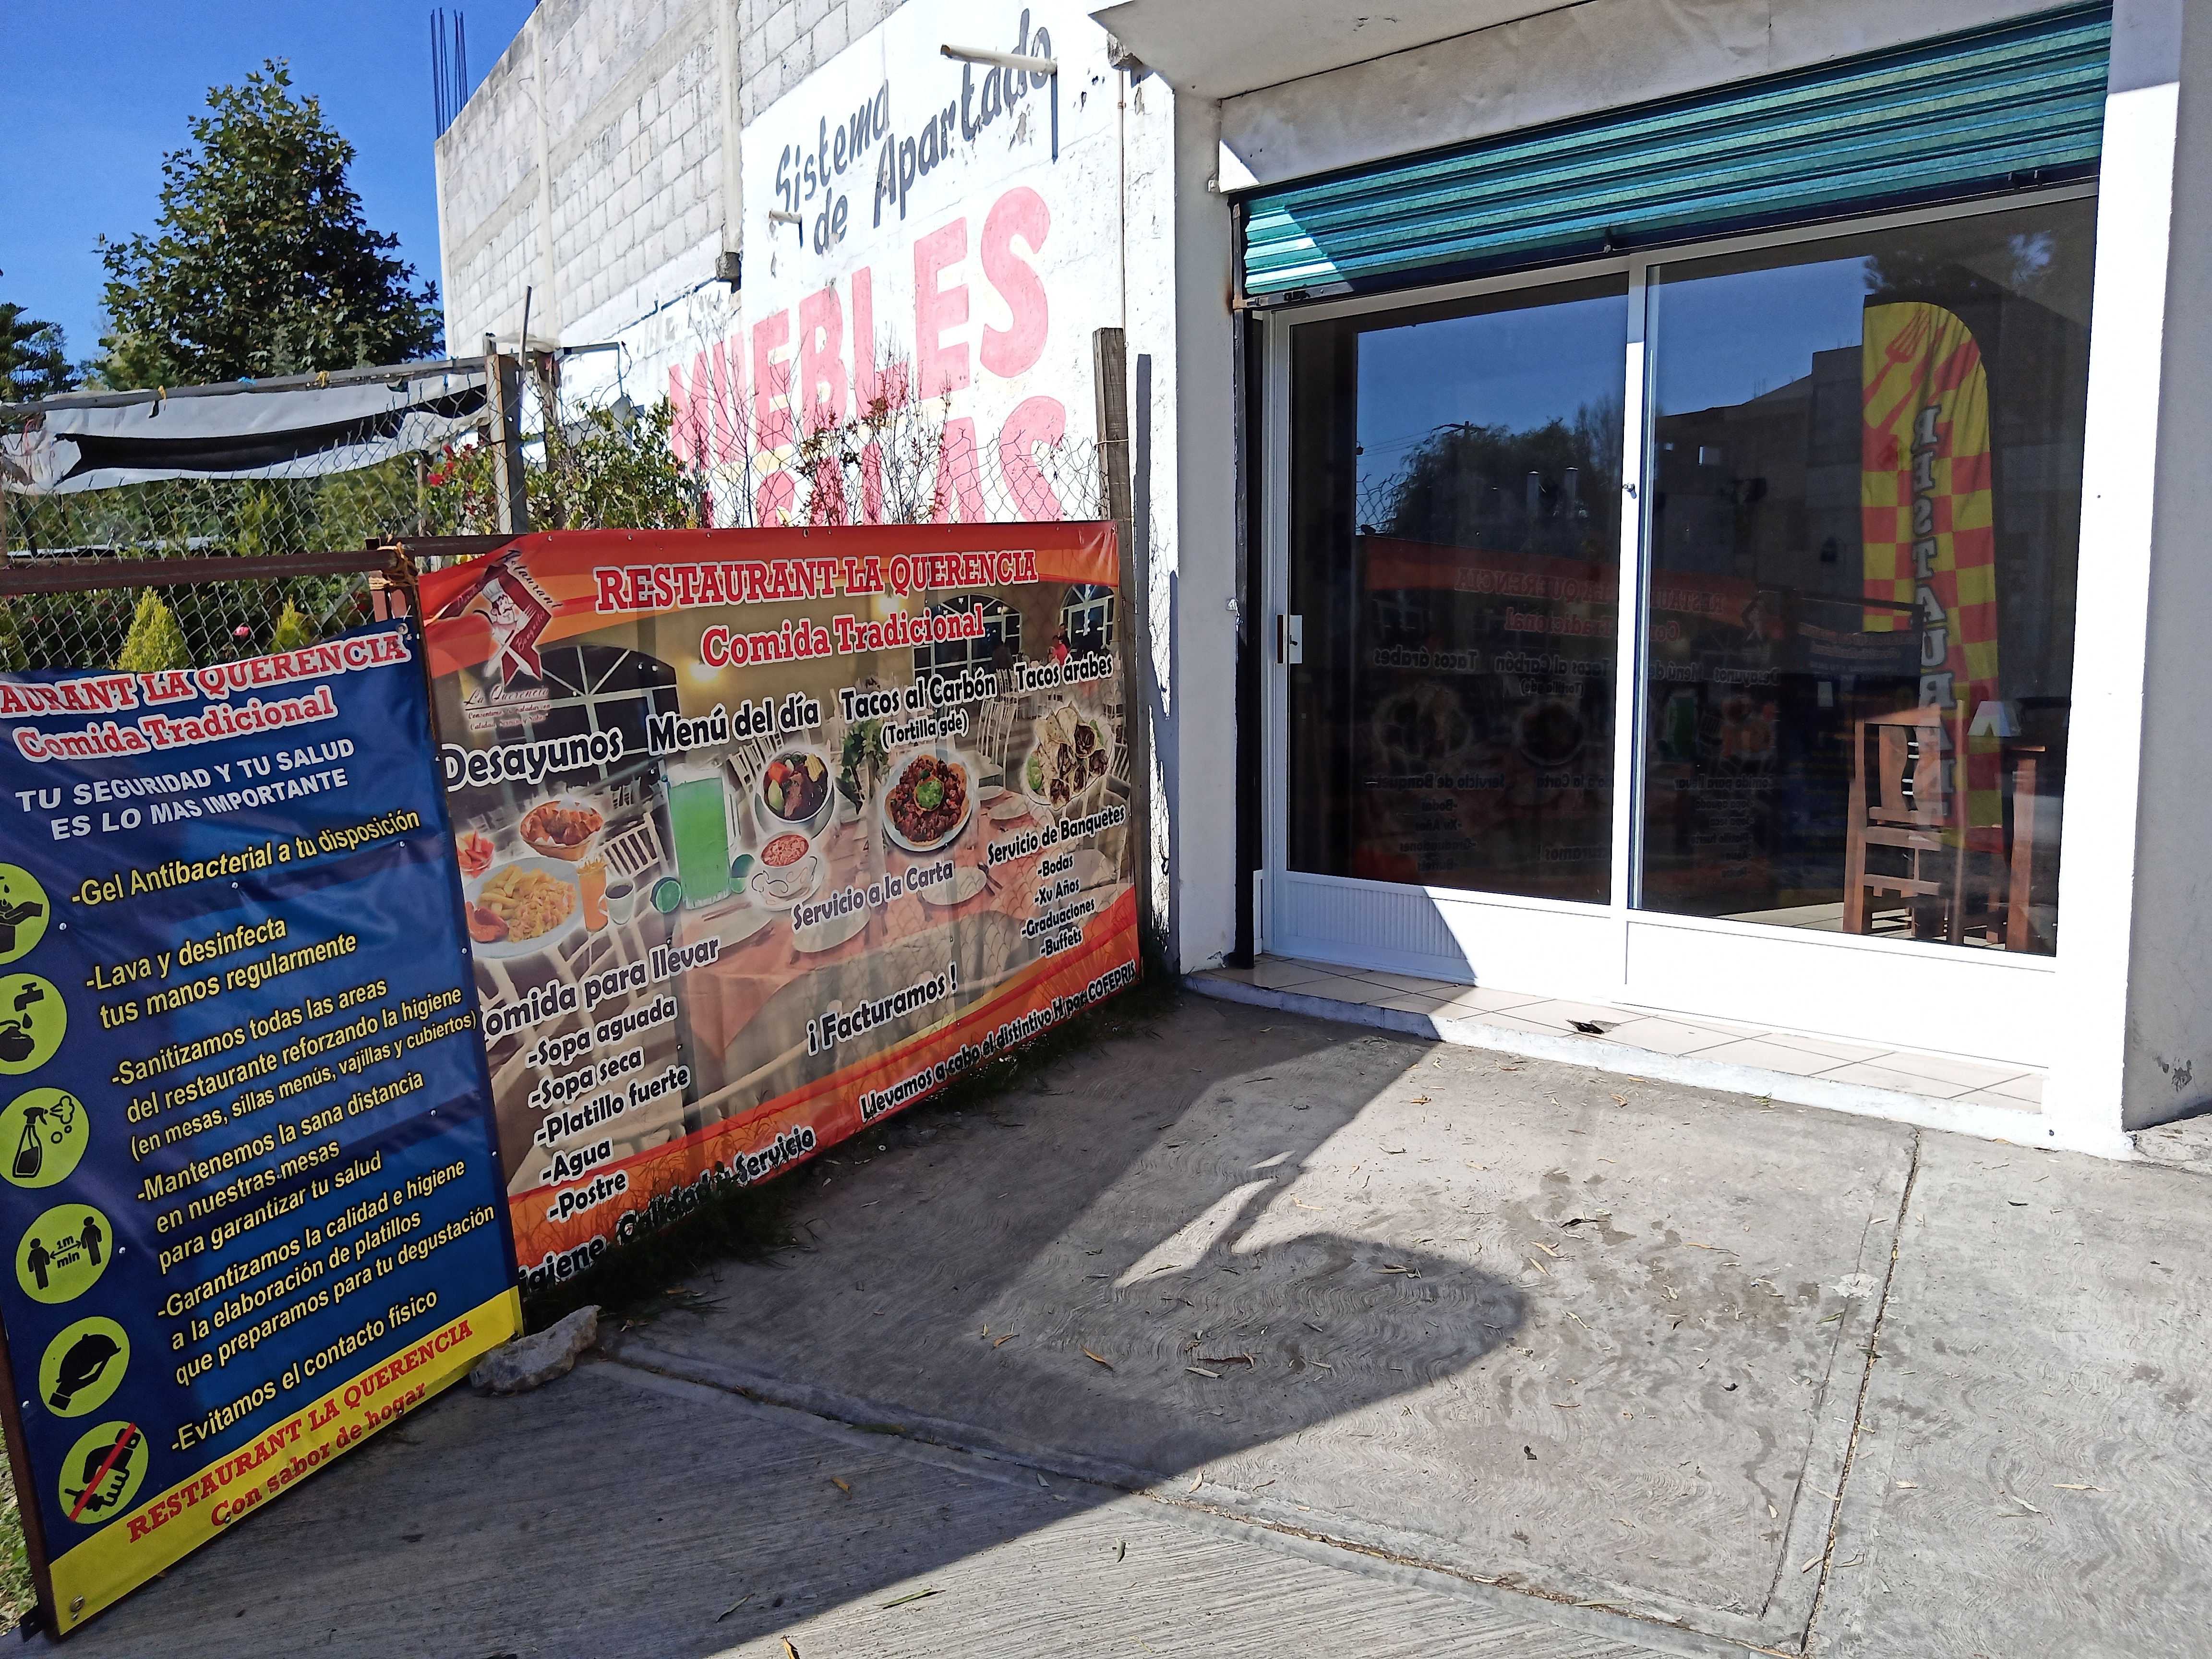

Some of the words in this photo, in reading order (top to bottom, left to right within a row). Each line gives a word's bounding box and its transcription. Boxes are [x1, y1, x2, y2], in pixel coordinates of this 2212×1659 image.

[775, 81, 891, 212] Sistema
[815, 190, 848, 255] de
[874, 9, 1052, 228] Apartado
[597, 563, 838, 611] RESTAURANT
[845, 557, 883, 592] LA
[890, 552, 1038, 596] QUERENCIA
[145, 671, 193, 702] LA
[198, 635, 407, 694] QUERENCIA
[703, 619, 831, 667] Comida
[835, 605, 984, 653] Tradicional
[842, 689, 900, 720] Tacos
[906, 686, 924, 711] al
[928, 668, 996, 705] Carbón
[1016, 662, 1058, 690] Tacos
[1063, 655, 1113, 683] árabes
[17, 723, 147, 757] Comida
[145, 690, 334, 746] Tradicional
[649, 709, 727, 753] Menú
[734, 701, 774, 737] del
[781, 693, 819, 732] día
[882, 725, 938, 751] (Tortilla
[939, 715, 969, 740] gde)
[15, 788, 62, 812] TU
[72, 764, 212, 805] SEGURIDAD
[214, 764, 233, 782] Y
[236, 755, 271, 778] TU
[278, 738, 354, 770] SALUD
[442, 733, 622, 785] Desayunos
[51, 814, 92, 841] ES
[102, 808, 142, 833] LO
[151, 795, 203, 825] MAS
[205, 769, 349, 815] IMPORTANTE
[988, 838, 1038, 866] Servicio
[1042, 826, 1058, 846] de
[1061, 806, 1124, 843] Banquetes
[71, 875, 123, 907] -Gel
[131, 842, 274, 897] Antibacterial
[278, 846, 292, 862] a
[296, 836, 317, 858] tu
[319, 809, 421, 854] disposición
[1037, 856, 1073, 877] -Bodas
[1056, 879, 1080, 900] Años
[793, 889, 865, 930] Servicio
[868, 888, 880, 903] a
[883, 879, 902, 900] la
[906, 862, 953, 892] Carta
[1022, 900, 1095, 937] -Graduaciones
[86, 956, 152, 992] -Lava
[158, 950, 171, 979] y
[179, 918, 288, 968] desinfecta
[1041, 930, 1082, 957] -Buffets
[100, 999, 139, 1030] tus
[146, 976, 221, 1015] manos
[225, 932, 358, 995] regularmente
[481, 984, 577, 1040] omida
[585, 961, 646, 1003] para
[651, 937, 720, 984] llevar
[823, 976, 946, 1046] Facturamos
[111, 1025, 245, 1086] -Sanitizamos
[249, 1004, 303, 1040] todas
[307, 998, 335, 1022] las
[338, 979, 387, 1010] areas
[126, 1091, 160, 1124] del
[165, 1051, 278, 1109] restaurante
[282, 1013, 379, 1067] reforzando
[382, 1009, 398, 1028] la
[401, 987, 463, 1023] higiene
[528, 1028, 590, 1068] -Sopa
[597, 998, 676, 1044] aguada
[862, 1069, 932, 1119] Llevamos
[936, 1063, 945, 1081] a
[983, 1034, 994, 1055] el
[997, 1012, 1051, 1048] distintivo
[1054, 1002, 1065, 1021] H
[1088, 962, 1136, 1001] COFEPRIS
[130, 1135, 161, 1163] (en
[165, 1108, 228, 1145] mesas,
[231, 1090, 275, 1119] sillas
[278, 1064, 337, 1099] menús,
[338, 1038, 392, 1077] vajillas
[394, 1042, 404, 1058] y
[406, 1009, 478, 1050] cubiertos)
[530, 1067, 594, 1108] -Sopa
[600, 1050, 642, 1081] seca
[537, 1095, 624, 1145] -Platillo
[629, 1067, 689, 1107] fuerte
[136, 1133, 275, 1203] -Mantenemos
[278, 1123, 298, 1146] la
[301, 1108, 345, 1138] sana
[348, 1071, 424, 1118] distancia
[542, 1139, 611, 1182] -Agua
[734, 1126, 815, 1185] Servicio
[156, 1211, 184, 1235] en
[189, 1172, 277, 1221] nuestras
[280, 1141, 340, 1182] mesas
[158, 1239, 205, 1274] para
[210, 1188, 306, 1253] garantizar
[311, 1178, 330, 1200] tu
[334, 1150, 382, 1190] salud
[550, 1173, 627, 1221] -Postre
[56, 1235, 74, 1250] 1m
[157, 1240, 300, 1319] -Garantizamos
[305, 1227, 323, 1249] la
[326, 1191, 389, 1238] calidad
[392, 1190, 403, 1206] e
[406, 1159, 466, 1202] higiene
[170, 1330, 184, 1351] a
[191, 1318, 210, 1341] la
[214, 1259, 324, 1331] elaboración
[328, 1248, 351, 1271] de
[355, 1211, 421, 1261] platillos
[175, 1350, 213, 1387] que
[218, 1287, 329, 1369] preparamos
[333, 1266, 373, 1303] para
[375, 1255, 394, 1277] tu
[397, 1204, 495, 1267] degustación
[171, 1381, 277, 1454] -Evitamos
[282, 1363, 301, 1392] el
[304, 1319, 385, 1377] contacto
[389, 1290, 438, 1330] físico
[127, 1416, 303, 1545] RESTAURANT
[308, 1399, 341, 1432] LA
[343, 1318, 474, 1409] QUERENCIA
[210, 1489, 263, 1531] Con
[265, 1440, 331, 1494] sabor
[337, 1421, 363, 1451] de
[365, 1381, 427, 1435] hogar
